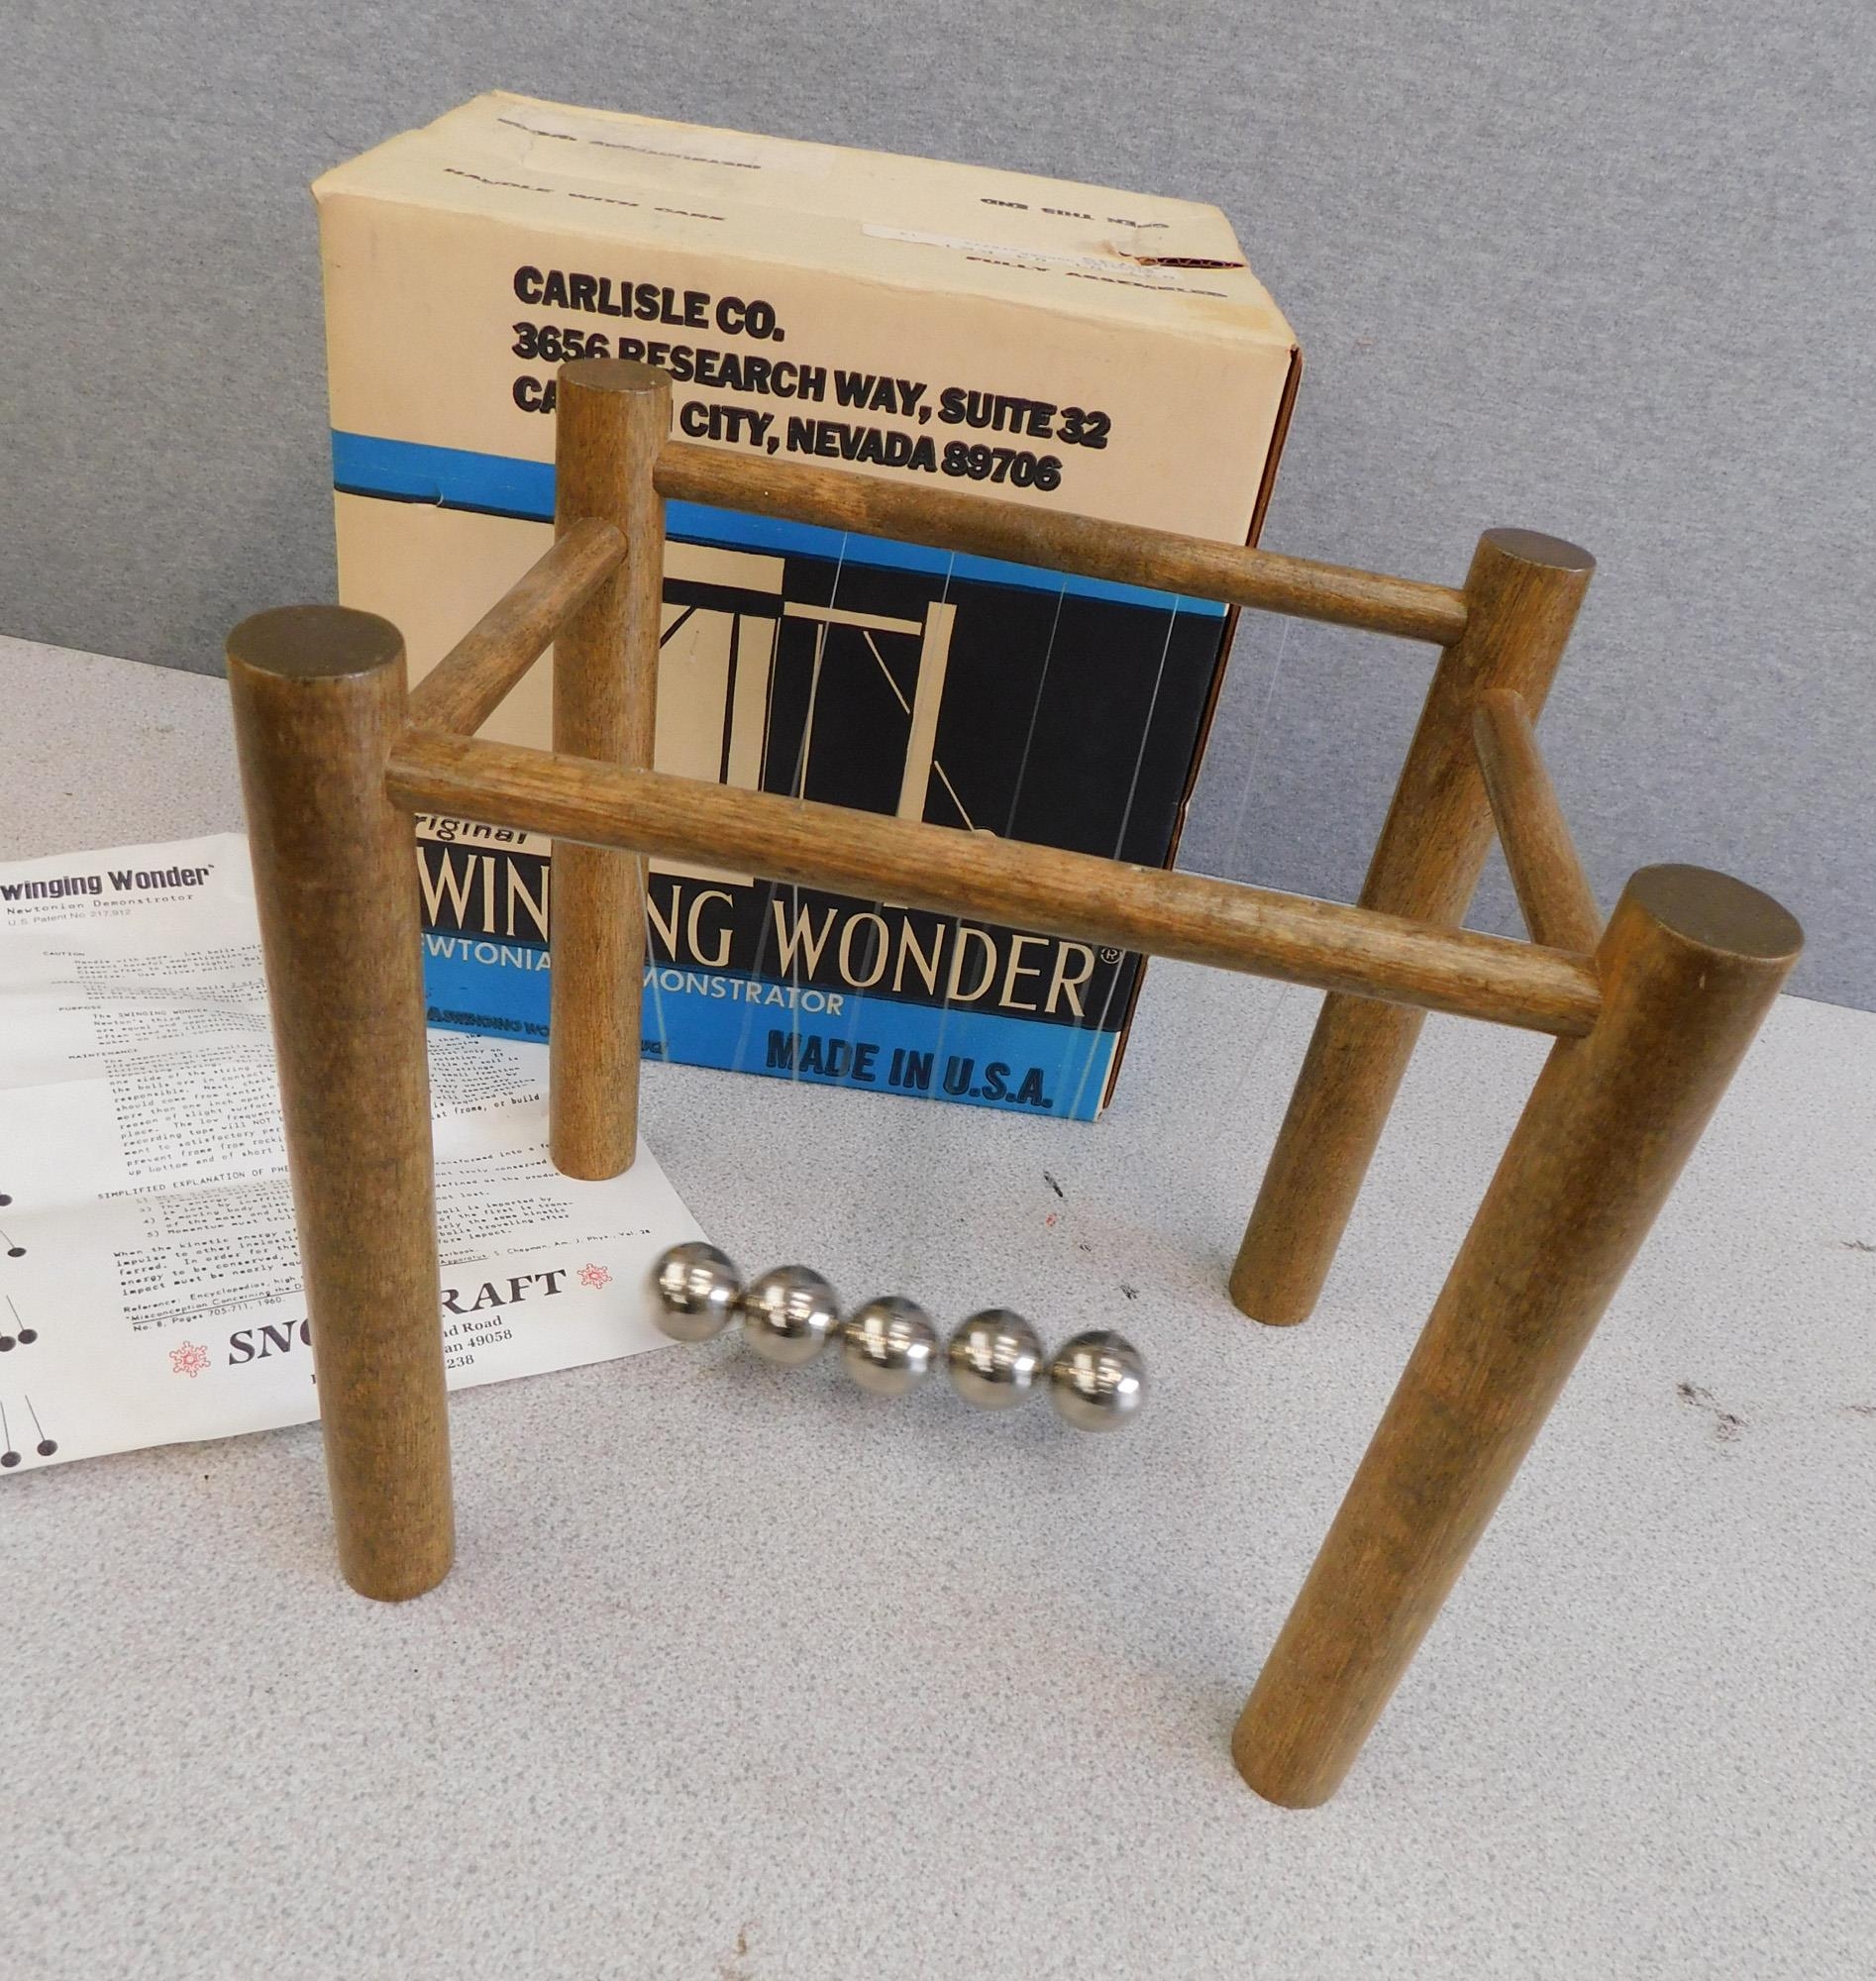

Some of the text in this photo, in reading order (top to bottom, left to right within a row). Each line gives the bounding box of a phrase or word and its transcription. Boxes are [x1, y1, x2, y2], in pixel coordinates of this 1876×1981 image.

[513, 265, 785, 342] CARLISLE CO.
[511, 321, 611, 364] 3656
[618, 337, 827, 401] RESEARCH
[834, 369, 933, 425] WAY,
[938, 386, 1058, 439] SUITE
[1056, 406, 1111, 449] 32
[679, 400, 1063, 491] CITY, NEVADA 89706
[412, 814, 528, 844] riginal
[7, 893, 195, 915] Newtonian Demonstrator
[765, 1029, 1055, 1109] MADE IN U.S.A.
[510, 1093, 540, 1104] build
[97, 1184, 166, 1199] SIMPLIFIED
[172, 1171, 246, 1189] EXPLANATION
[252, 1168, 264, 1178] OF
[462, 1315, 503, 1333] Road
[468, 1329, 513, 1349] 49058
